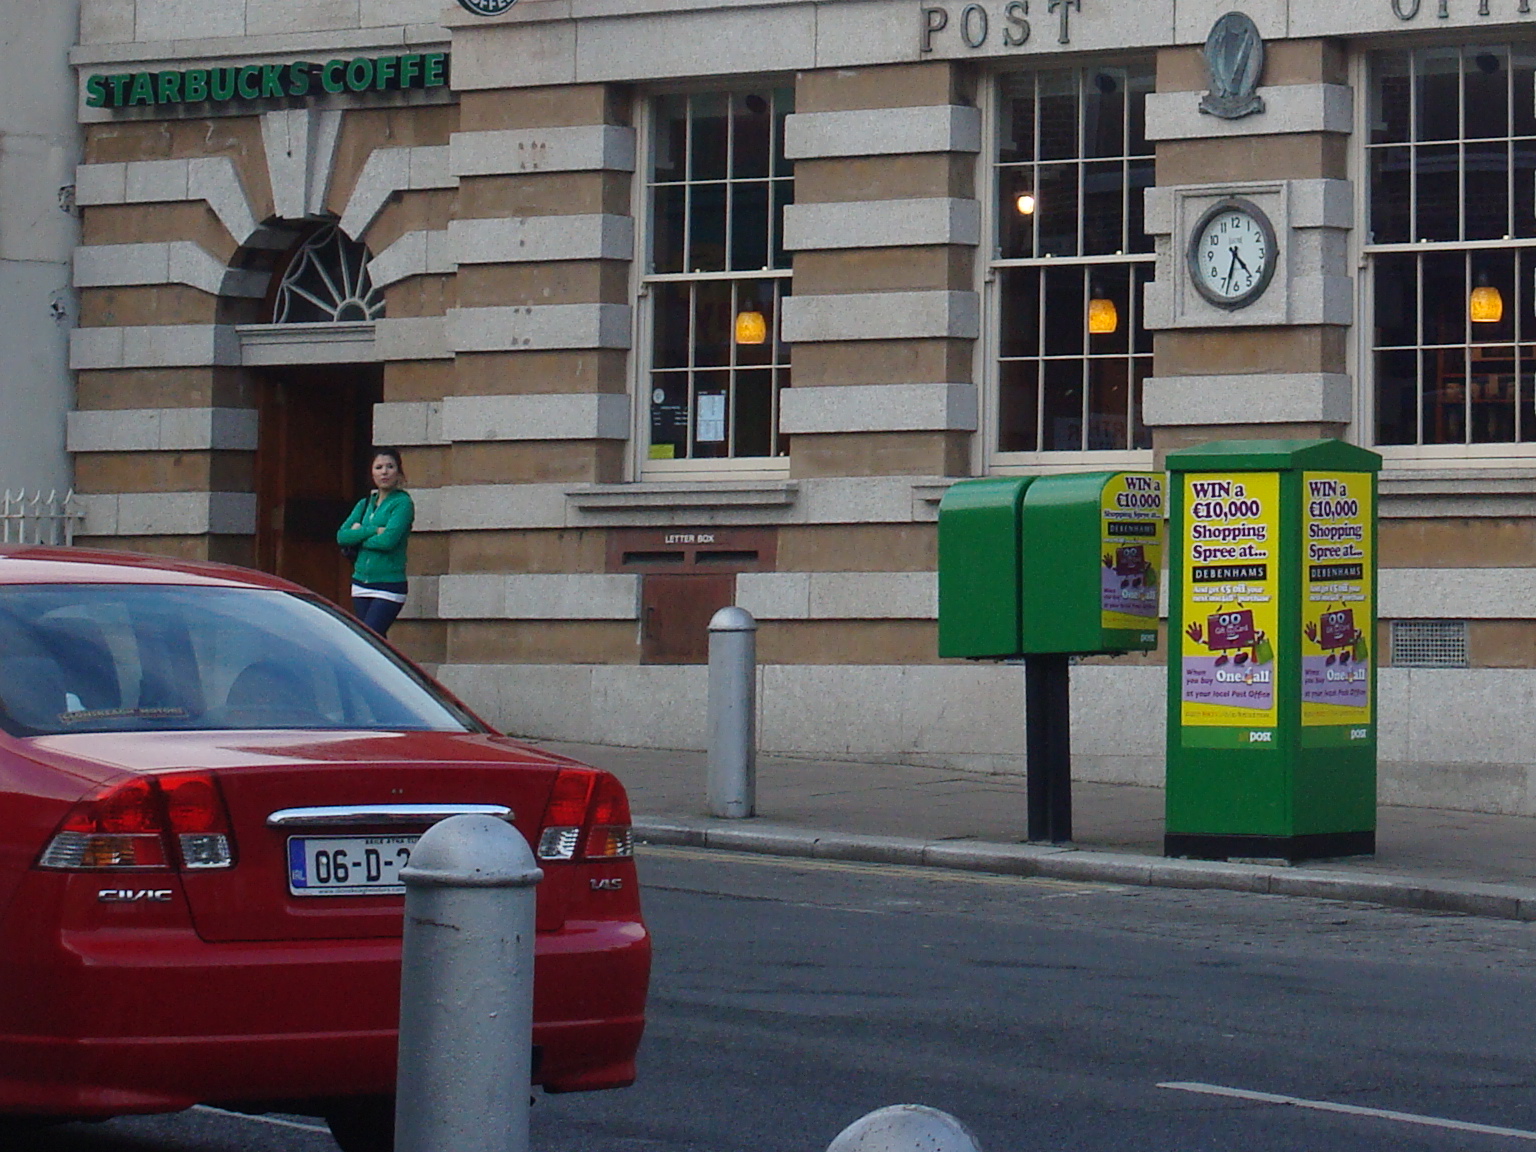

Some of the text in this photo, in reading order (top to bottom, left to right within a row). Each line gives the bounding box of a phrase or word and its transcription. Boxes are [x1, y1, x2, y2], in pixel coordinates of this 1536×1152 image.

[85, 62, 309, 108] STARBUCKS
[1220, 221, 1227, 234] 11
[1231, 217, 1241, 229] 12
[1246, 220, 1250, 232] 1
[1210, 235, 1219, 246] 10
[1254, 231, 1262, 243] 2
[1207, 251, 1214, 262] 9
[1259, 248, 1265, 260] 3
[1211, 266, 1218, 277] 8
[1255, 265, 1262, 275] 4
[1221, 277, 1227, 289] 7
[1233, 281, 1240, 292] 6
[1246, 276, 1252, 288] 5
[1125, 477, 1161, 492] WIN a
[1192, 482, 1244, 498] WIN a
[1309, 481, 1347, 497] WIN a
[1192, 500, 1260, 522] €10,000
[1309, 500, 1358, 522] €10,000
[1109, 524, 1155, 533] DEBENHAMS
[1192, 523, 1266, 540] Shopping
[1309, 523, 1362, 540] Shopping
[665, 534, 715, 544] LETTER BOX
[1192, 545, 1236, 562] Spree
[1309, 544, 1340, 561] Spree
[1195, 567, 1264, 579] DEBENHAMS
[1311, 567, 1361, 578] DEBENHAMS
[1248, 690, 1270, 699] Office
[1250, 732, 1271, 743] post
[1350, 729, 1367, 739] post
[98, 889, 173, 903] CIVIC
